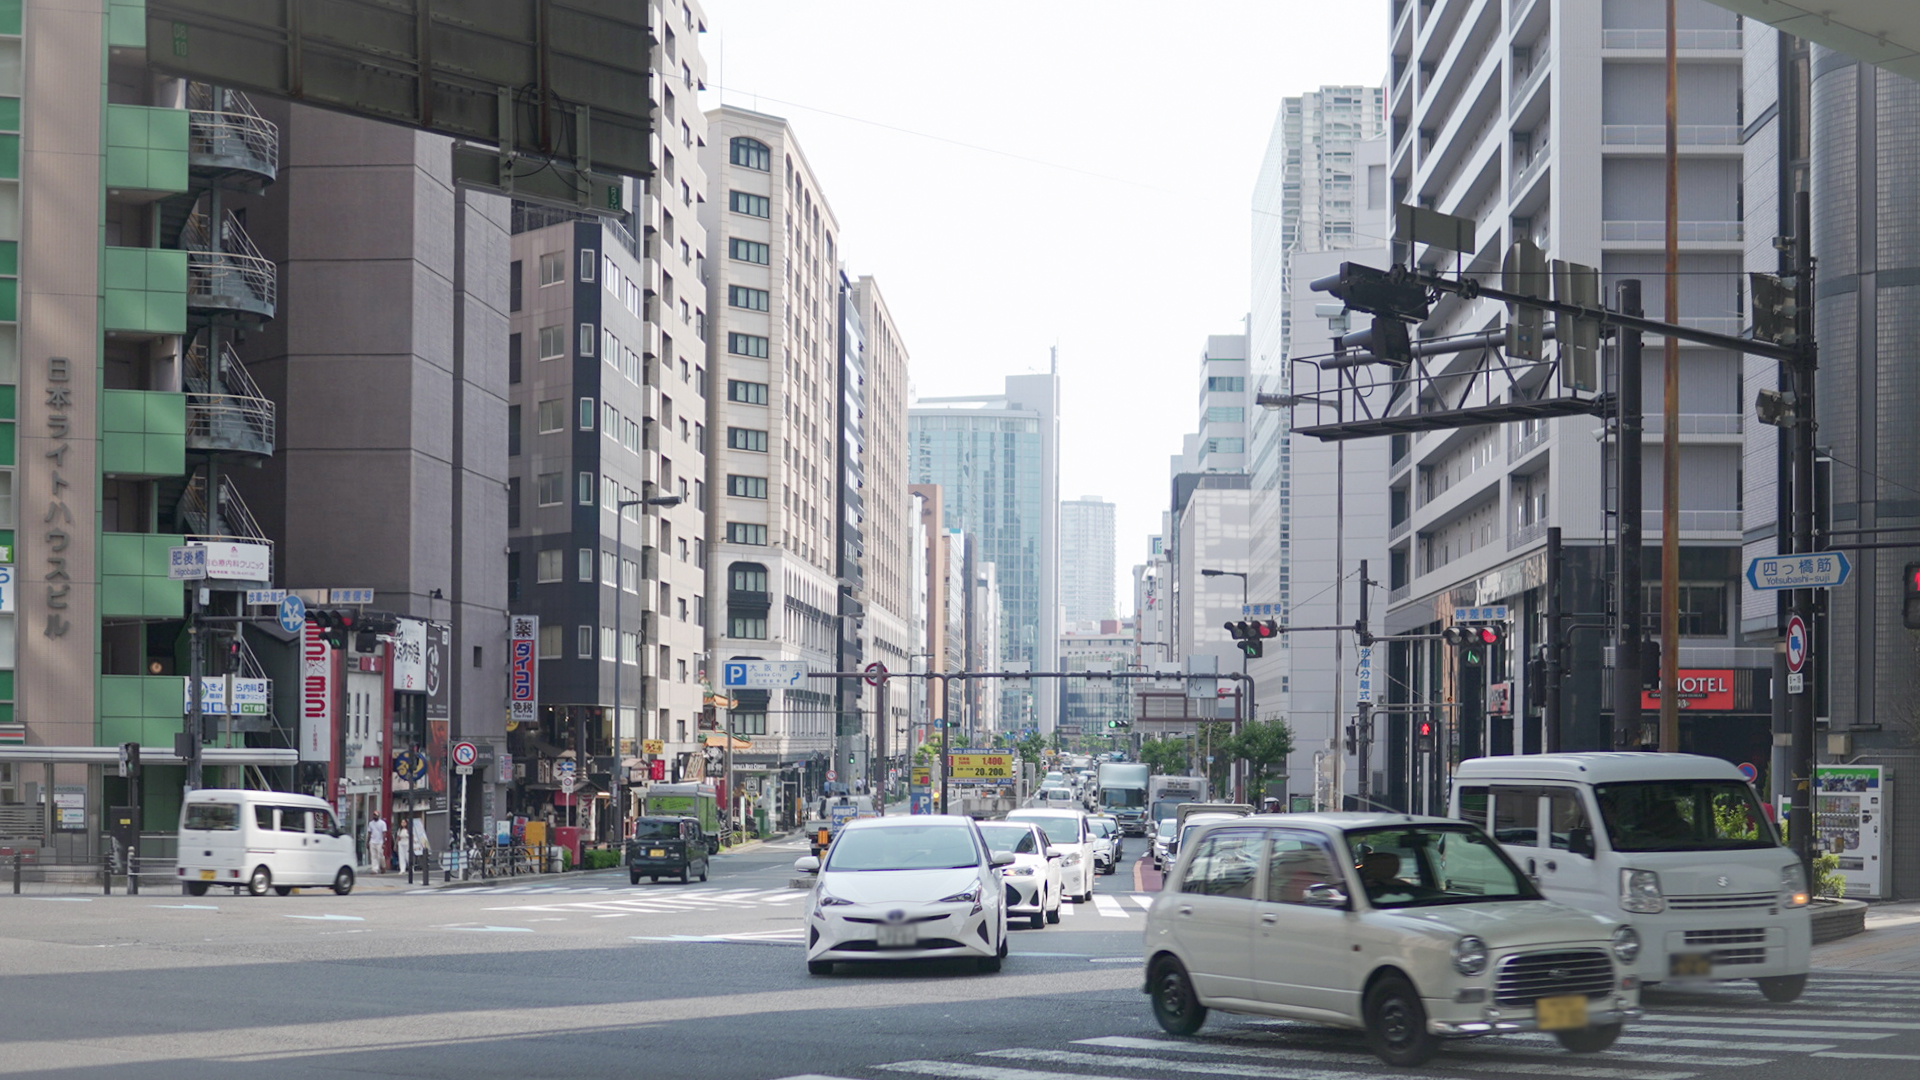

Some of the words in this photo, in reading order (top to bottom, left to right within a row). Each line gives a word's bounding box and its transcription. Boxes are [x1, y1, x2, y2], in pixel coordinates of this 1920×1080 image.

[44, 356, 72, 641] 日本ライトハウスビル
[172, 550, 205, 566] 肥後橋
[174, 568, 202, 577] Higobashi
[1763, 557, 1832, 577] 四つ橋筋
[1766, 574, 1831, 585] Yotsubashi-suji
[248, 591, 286, 604] 歩車分離式
[1242, 603, 1282, 615] 時差信号
[1455, 607, 1506, 620] 時差信号
[515, 618, 532, 637] 薬
[515, 641, 532, 699] ダイコク
[730, 665, 744, 684] P
[1359, 648, 1371, 701] 歩車分離式
[209, 683, 257, 693] きよら内科
[305, 676, 326, 718] mini
